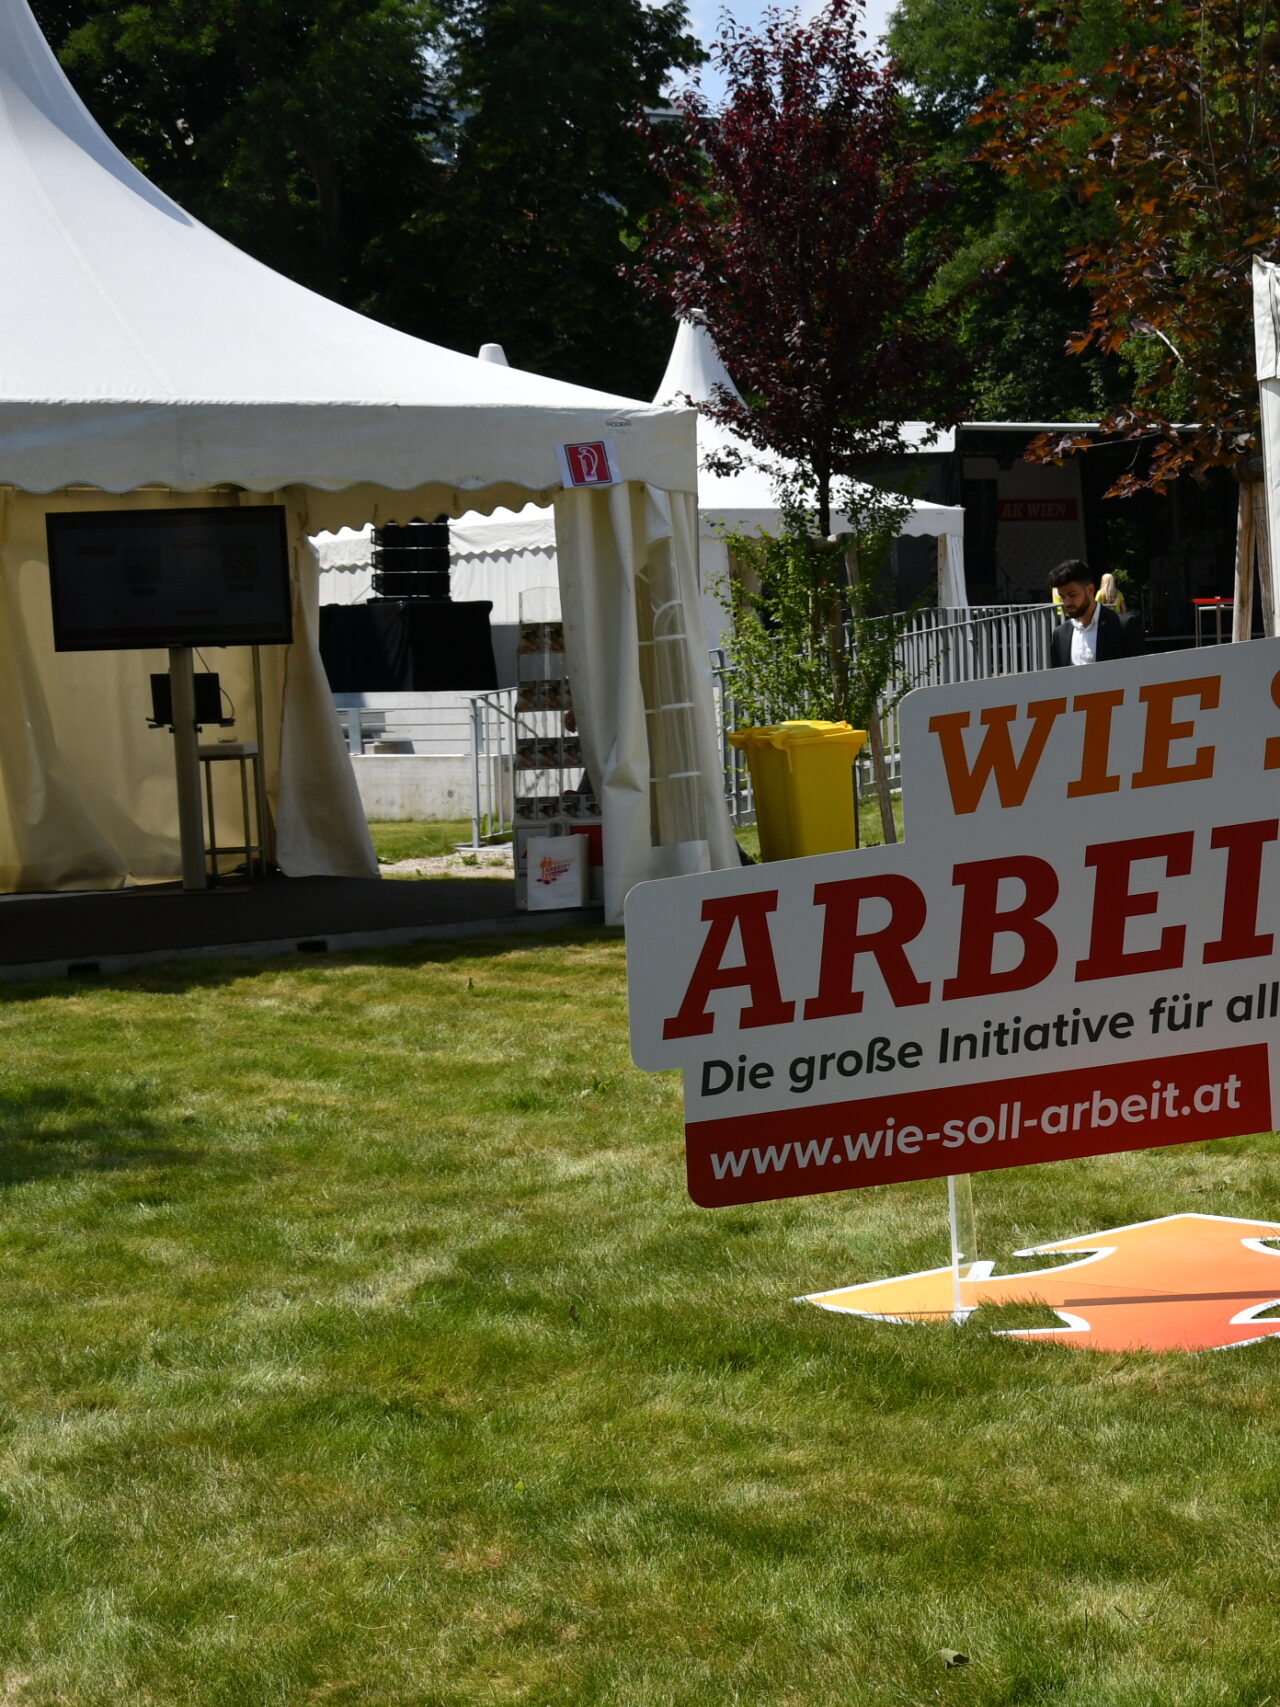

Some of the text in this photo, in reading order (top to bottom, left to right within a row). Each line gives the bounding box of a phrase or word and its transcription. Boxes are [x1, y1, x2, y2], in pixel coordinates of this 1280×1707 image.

[1001, 503, 1067, 518] AK WIEN
[928, 675, 1222, 816] WIE
[700, 1054, 775, 1097] Die
[788, 1036, 923, 1093] große
[938, 1007, 1135, 1065] Initiative
[1148, 994, 1212, 1034] für
[709, 1073, 1242, 1181] www.wie-soll-arbeit.at
